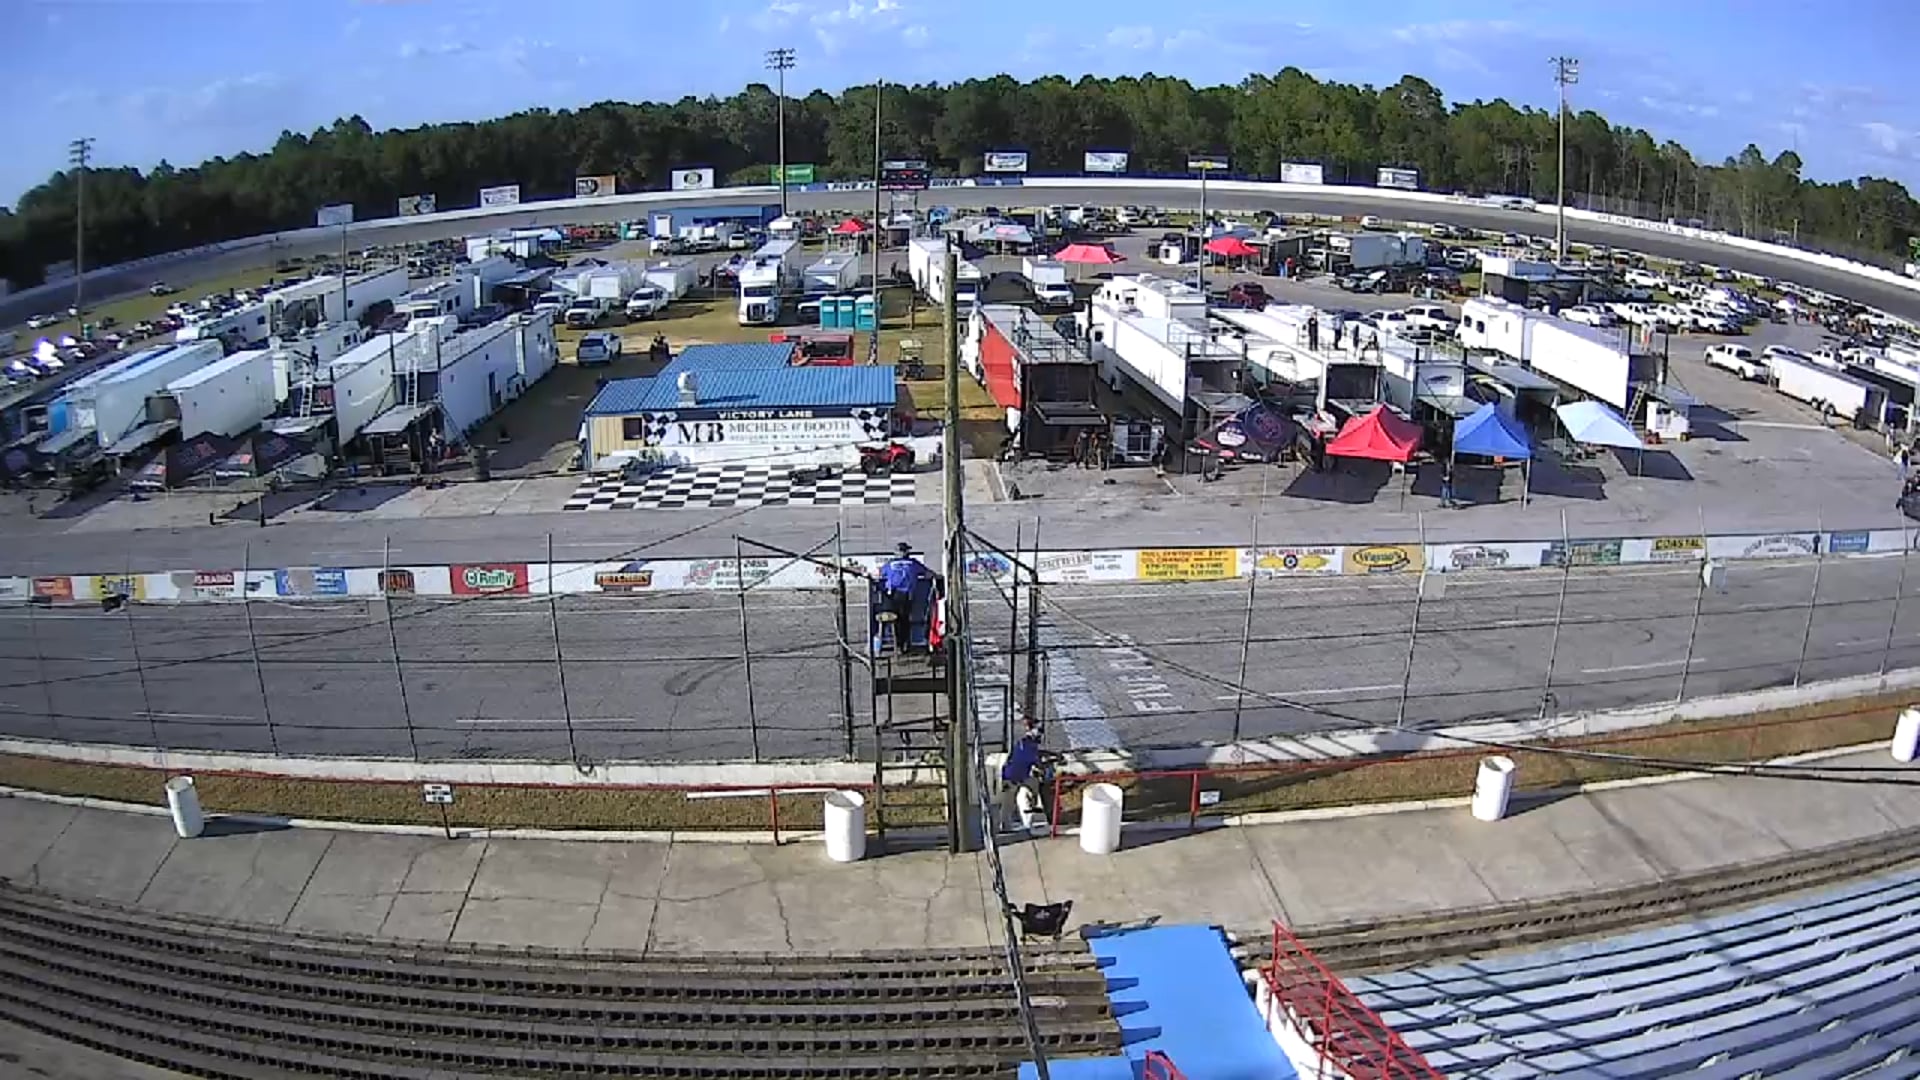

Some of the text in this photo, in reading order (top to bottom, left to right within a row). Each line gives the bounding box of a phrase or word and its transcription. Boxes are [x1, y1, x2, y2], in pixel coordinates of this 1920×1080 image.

[718, 410, 813, 419] VICTORY LANE
[729, 422, 788, 433] MICHLES
[804, 420, 851, 431] BOOTH
